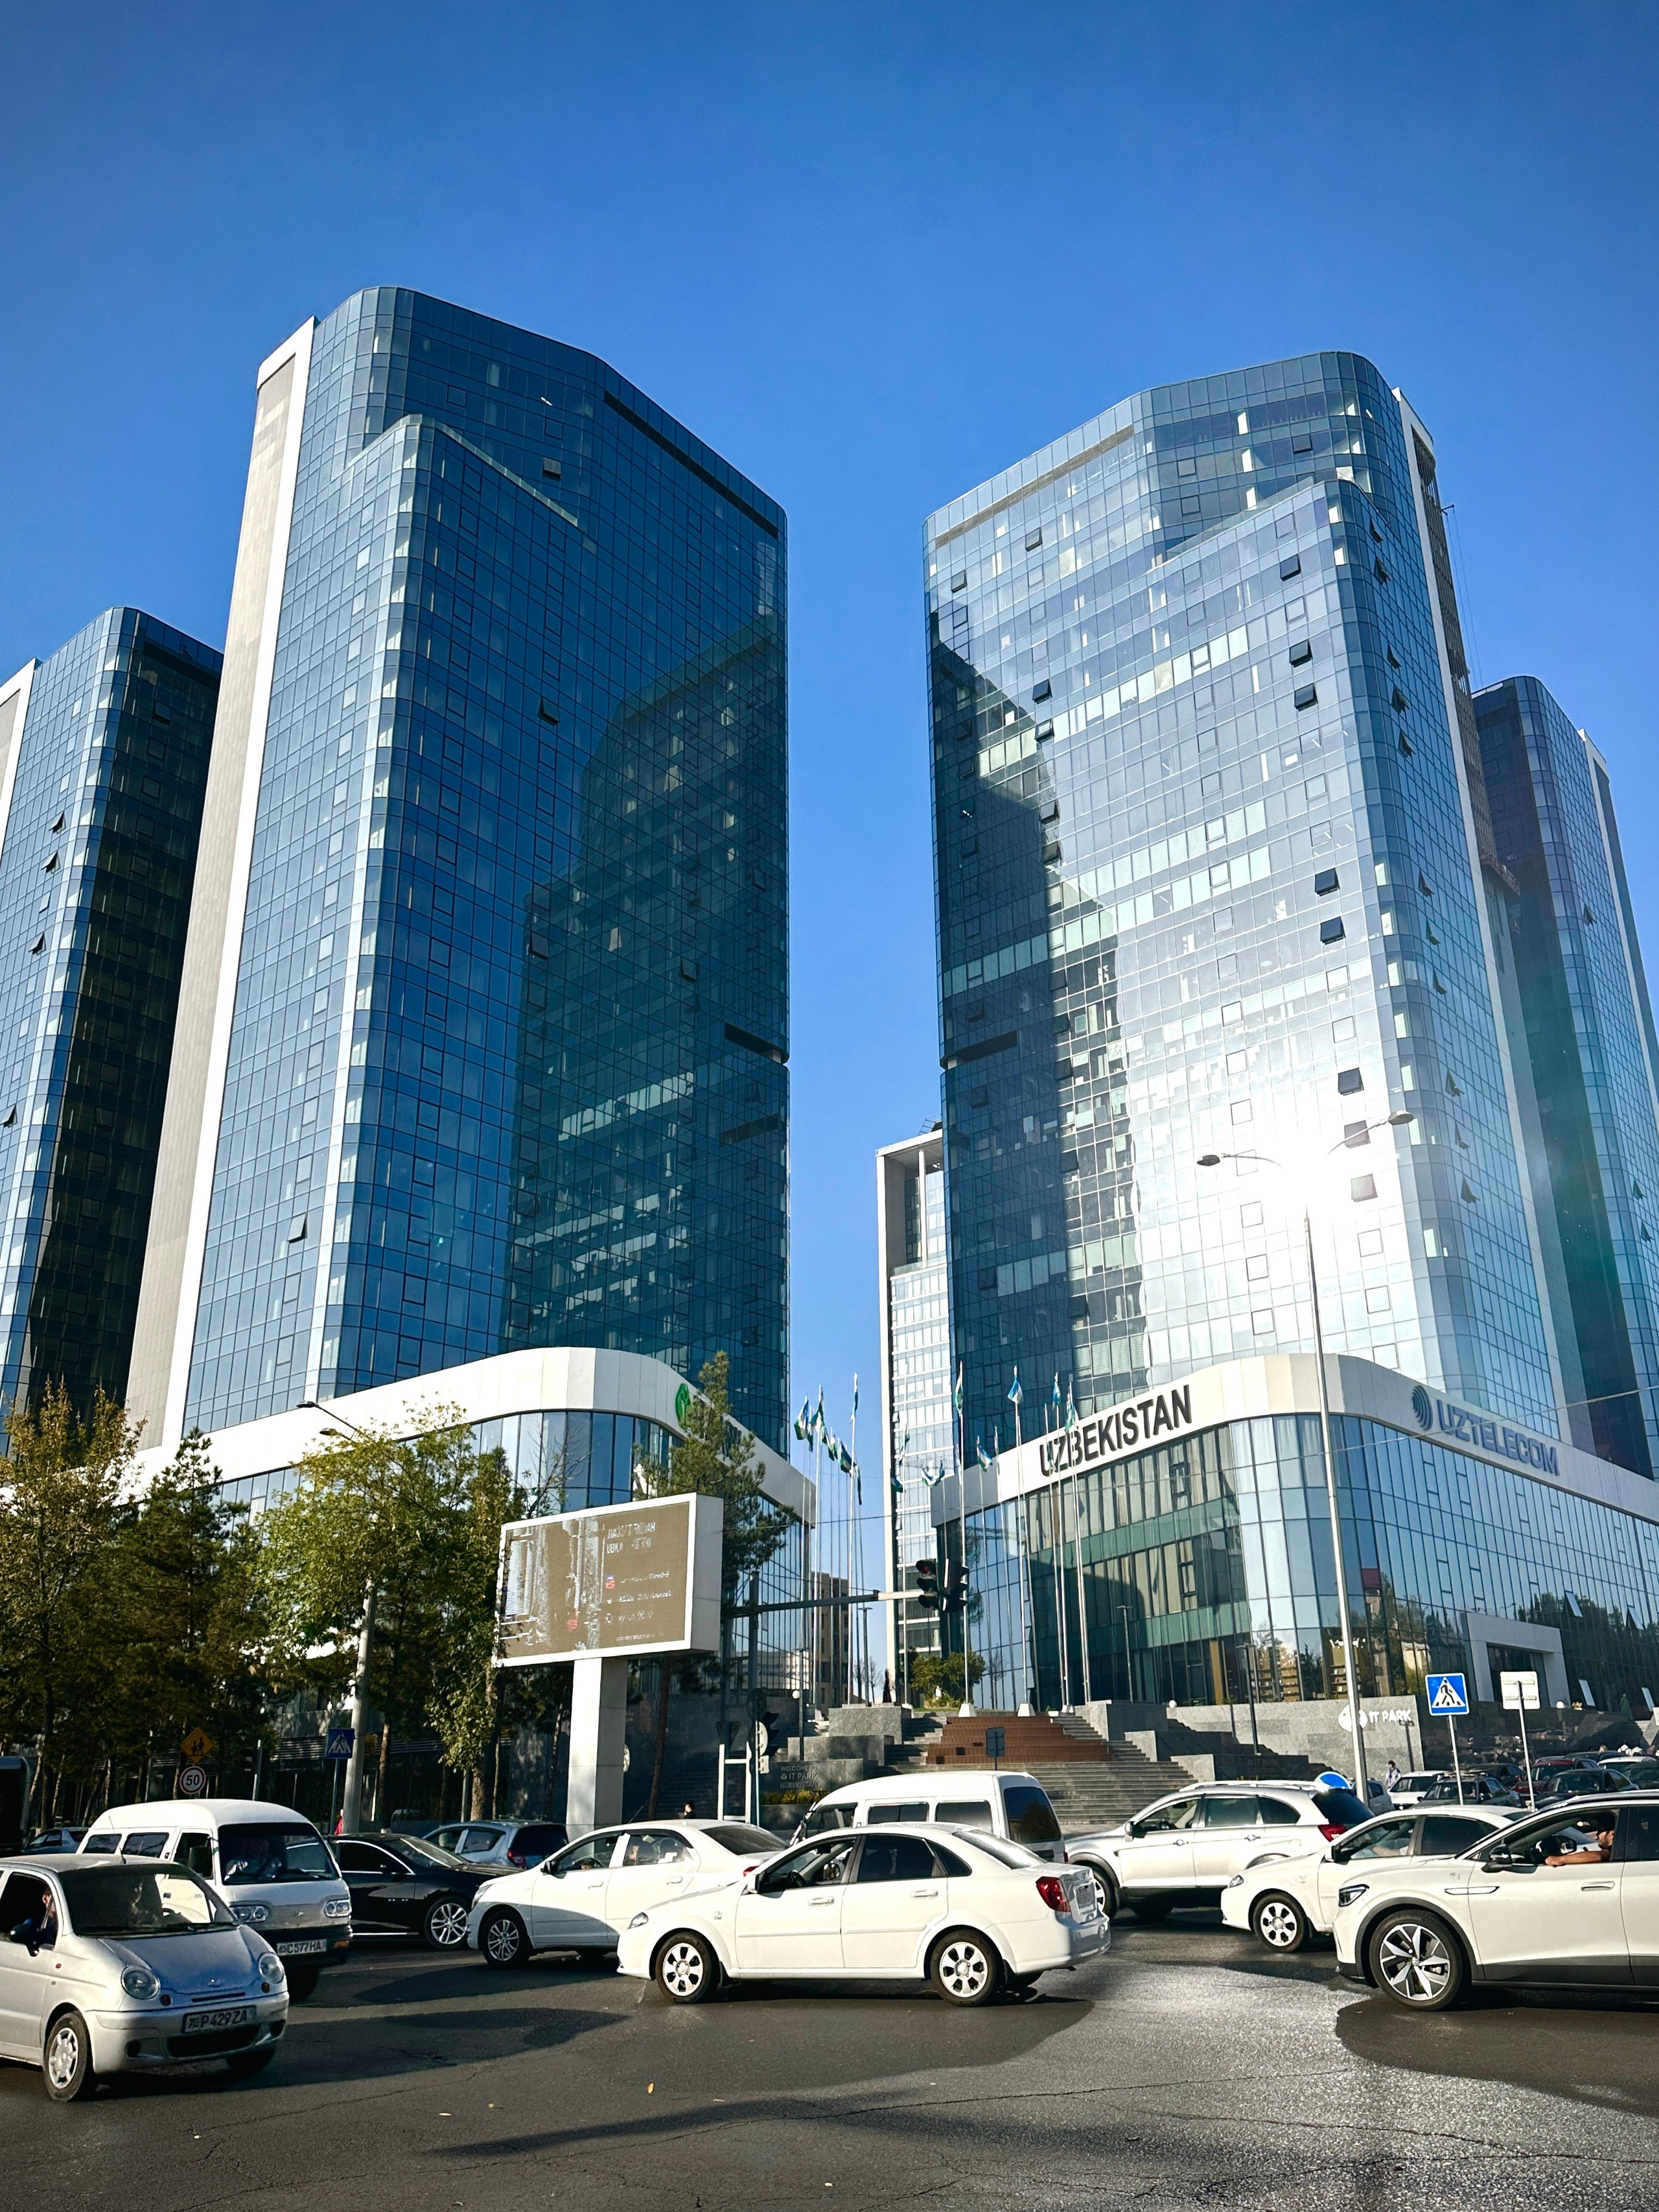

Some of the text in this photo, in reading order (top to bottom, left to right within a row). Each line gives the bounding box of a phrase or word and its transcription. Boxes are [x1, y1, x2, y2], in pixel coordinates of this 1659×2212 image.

[1039, 1384, 1192, 1477] UZBEKISTAN
[1437, 1399, 1560, 1476] UZTELECOM
[1369, 1709, 1412, 1723] IT PARK
[185, 1774, 200, 1786] 50
[797, 1772, 818, 1780] PARK
